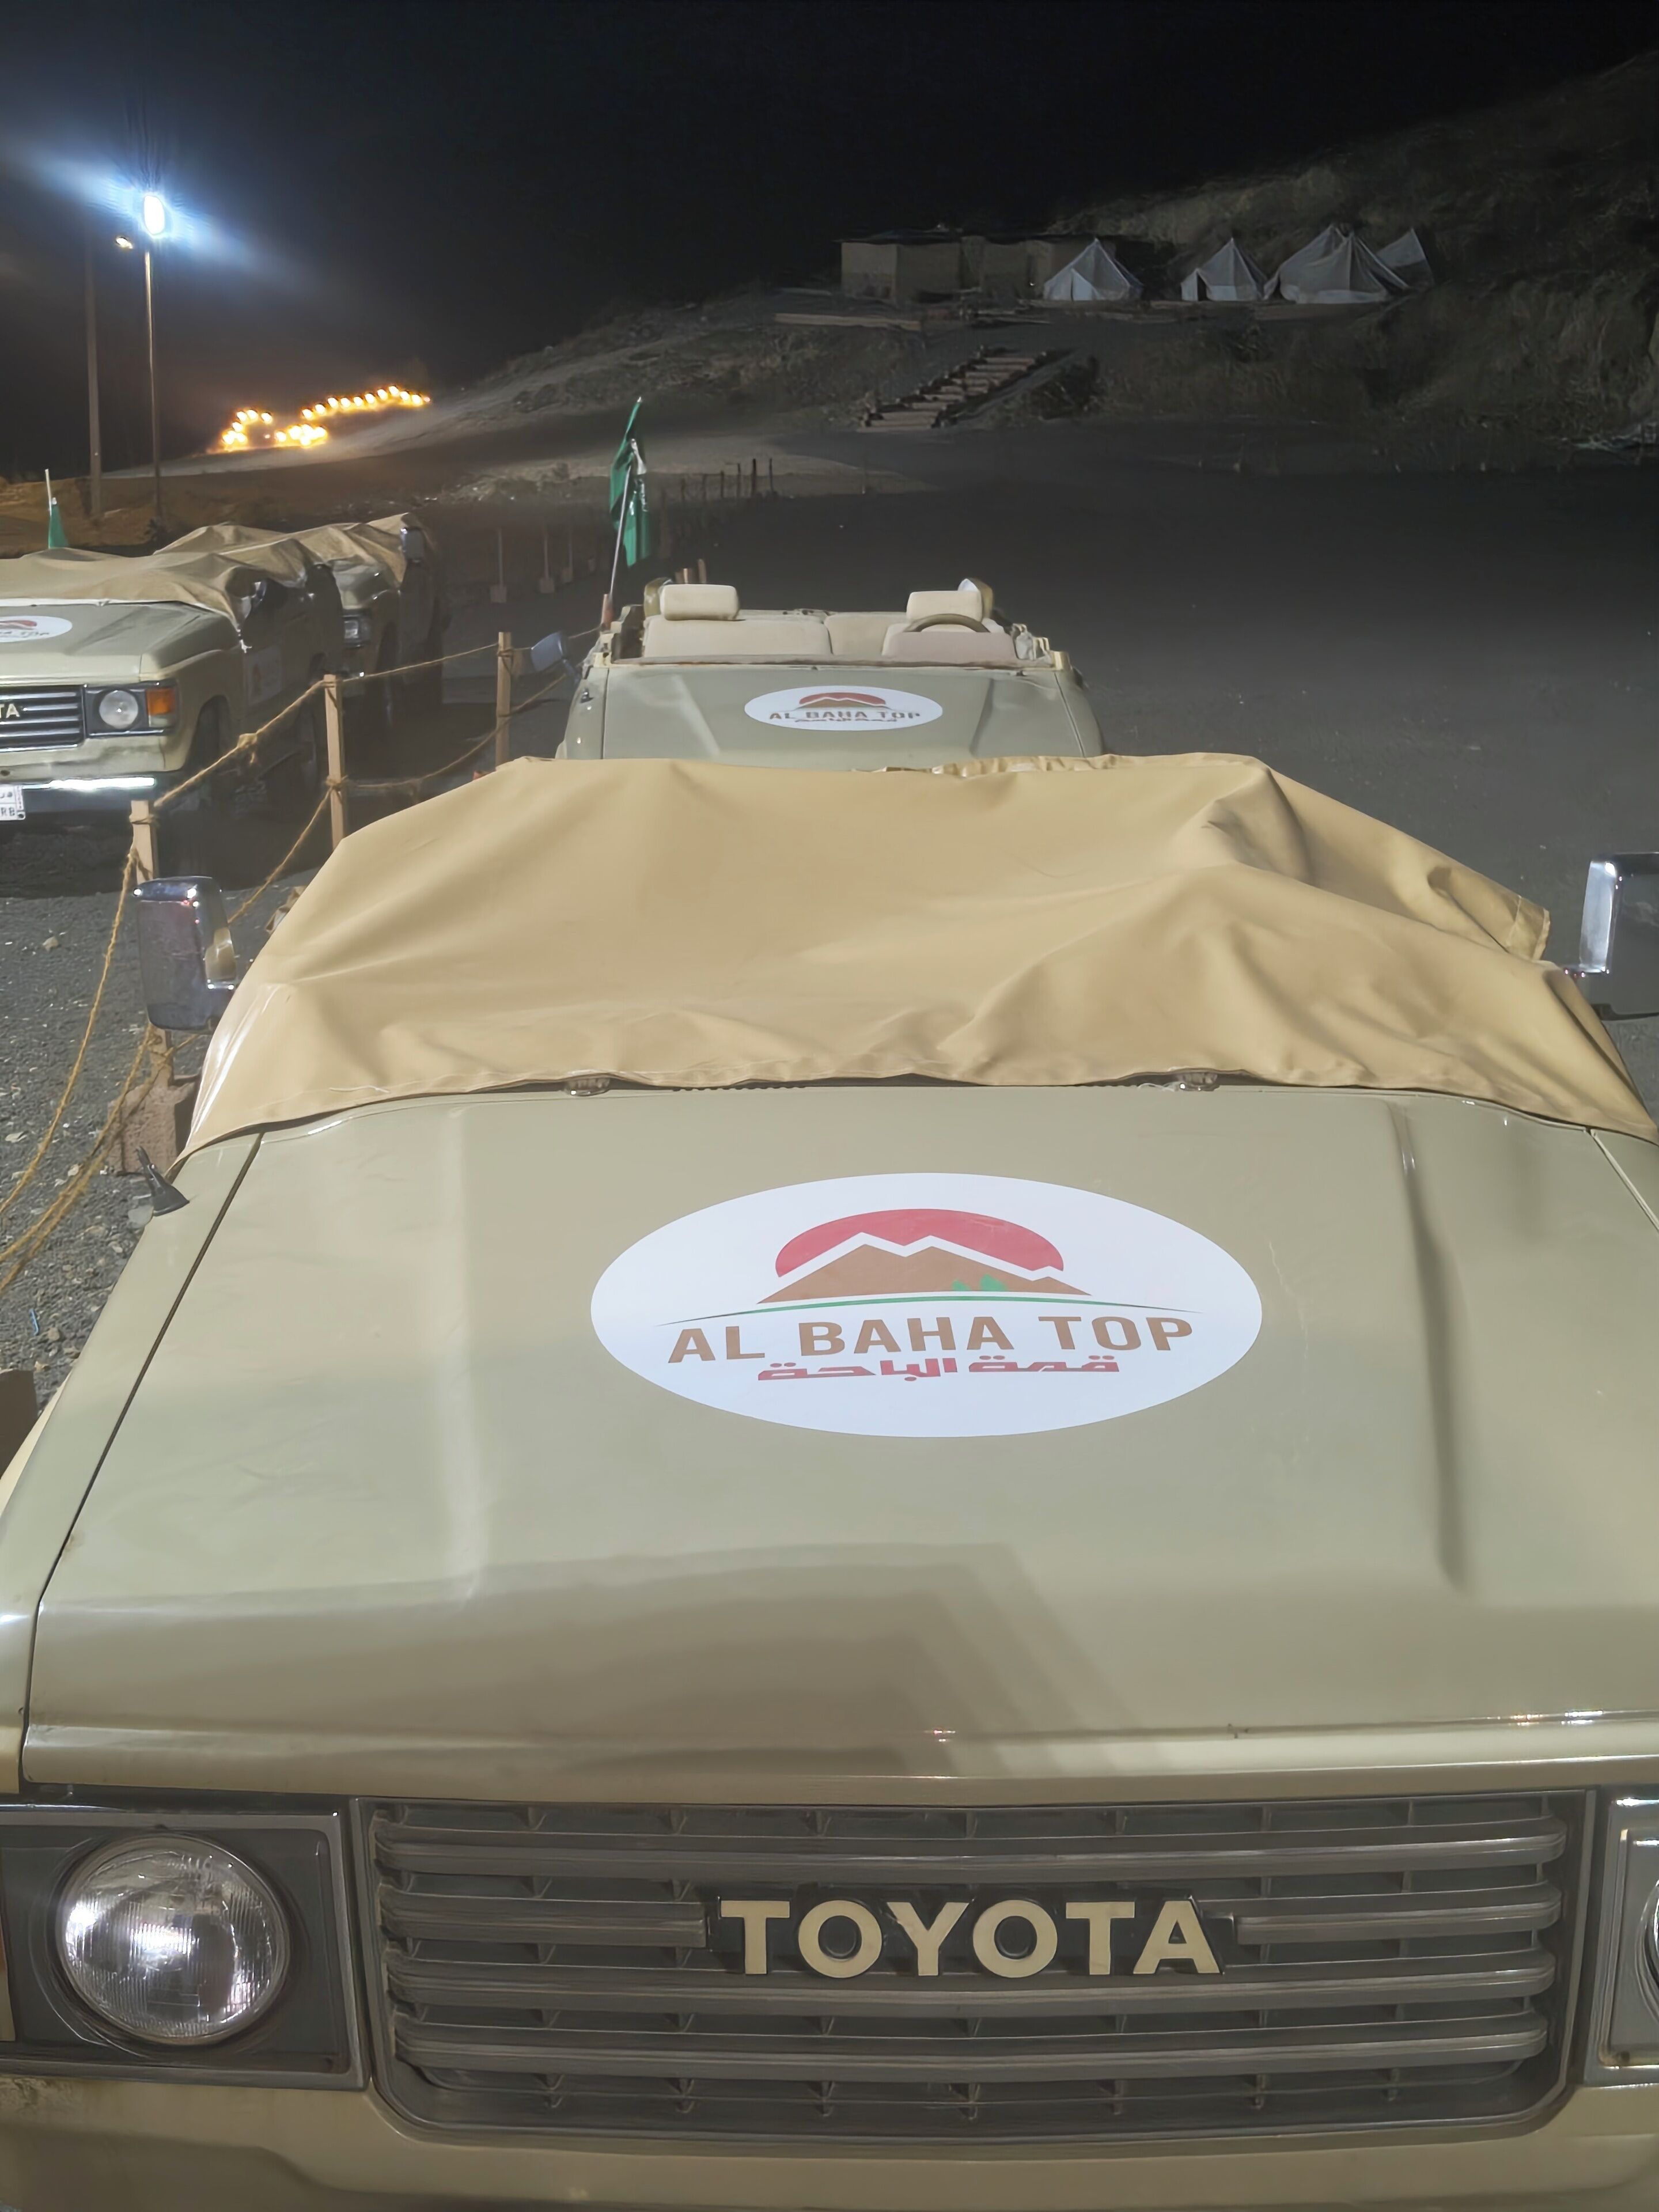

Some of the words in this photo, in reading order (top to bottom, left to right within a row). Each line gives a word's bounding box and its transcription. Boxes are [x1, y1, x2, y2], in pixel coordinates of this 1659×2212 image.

[668, 1325, 766, 1363] AL
[798, 1316, 1014, 1356] BAHA
[1038, 1316, 1193, 1351] TOP
[757, 1357, 958, 1381] الباحة
[969, 1355, 1120, 1372] قمة
[720, 1899, 1220, 1978] TOYOTA
